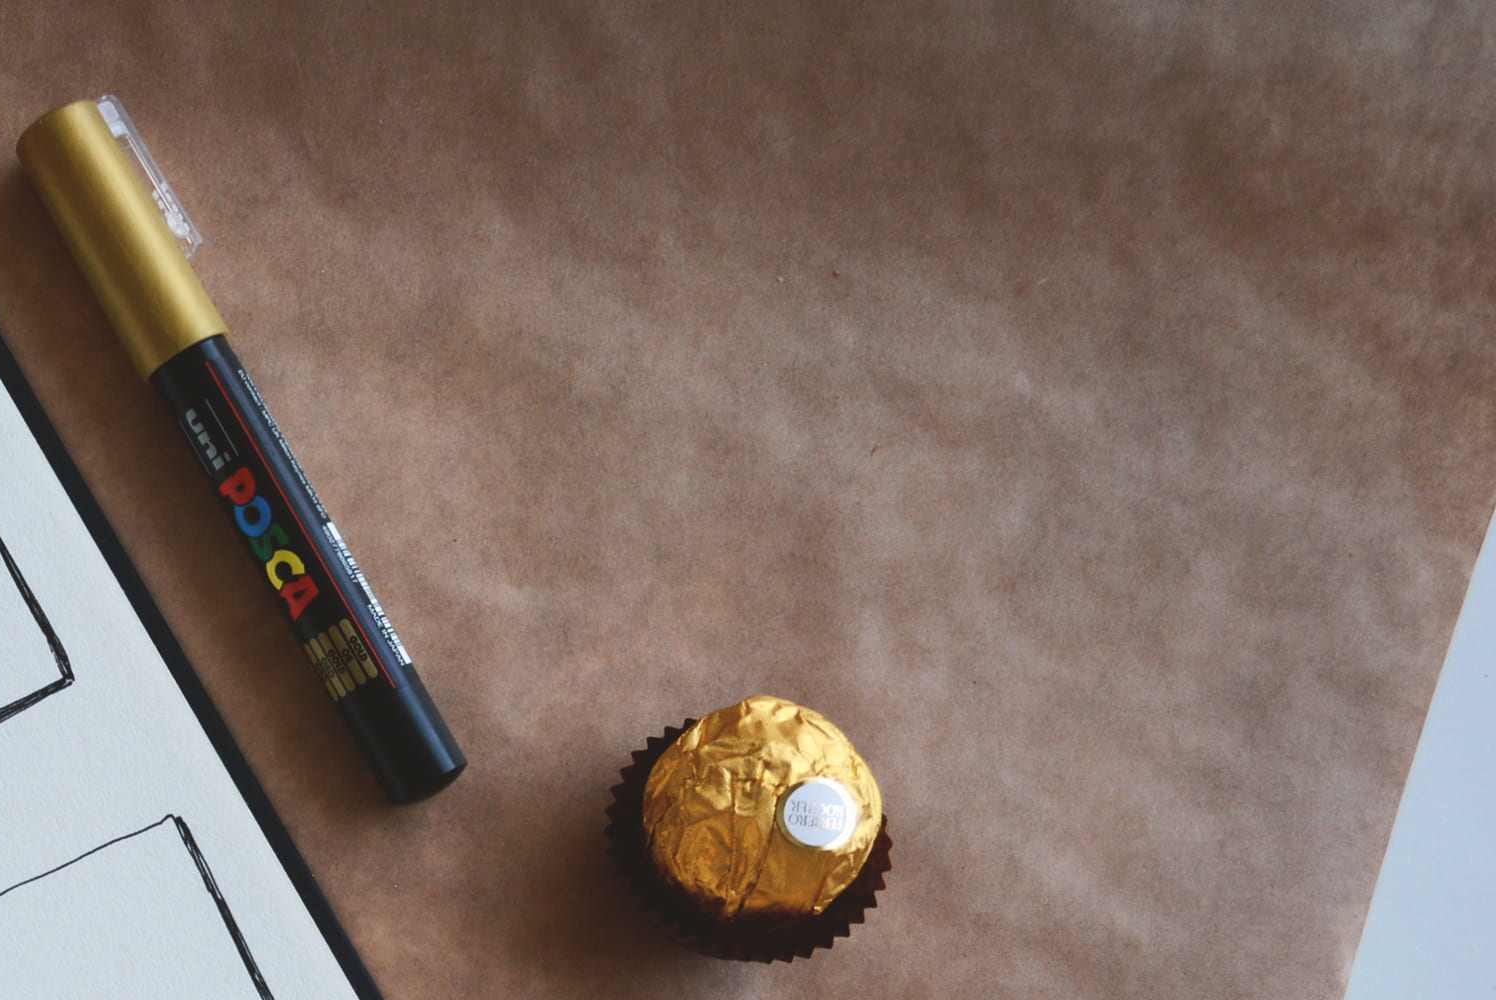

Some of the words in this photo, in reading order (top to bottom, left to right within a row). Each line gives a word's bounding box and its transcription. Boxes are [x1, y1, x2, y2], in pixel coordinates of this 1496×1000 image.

[186, 408, 232, 471] uni
[219, 466, 320, 621] POSCA
[350, 635, 367, 661] GOLD
